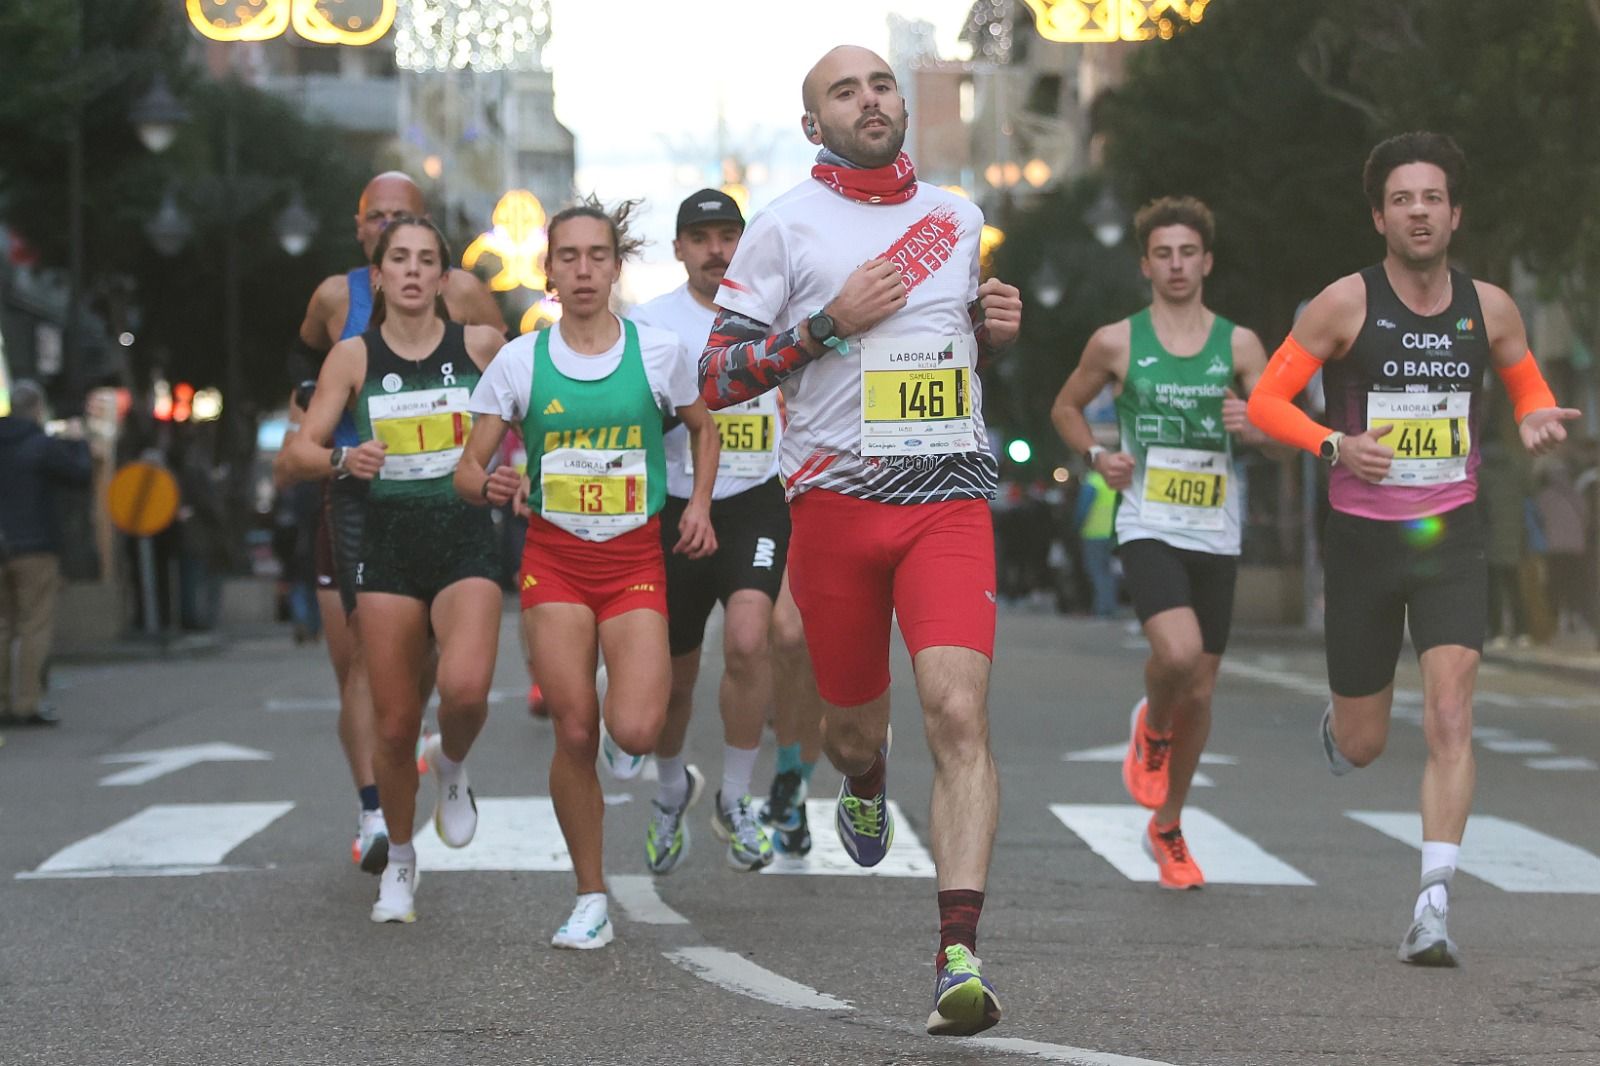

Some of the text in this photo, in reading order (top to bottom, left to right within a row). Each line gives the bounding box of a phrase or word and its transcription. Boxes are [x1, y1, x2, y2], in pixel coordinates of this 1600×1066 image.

[900, 267, 921, 290] DE
[1402, 332, 1453, 349] CUPA
[889, 352, 937, 362] LABORAL
[908, 372, 935, 380] SAMUEL
[1383, 361, 1470, 378] O BARCO
[899, 380, 944, 418] 146
[1391, 403, 1430, 413] LABORAL
[417, 423, 424, 450] 1
[1397, 427, 1437, 456] 414
[564, 460, 604, 470] LABORAL
[579, 483, 603, 513] 13
[1164, 477, 1206, 506] 409
